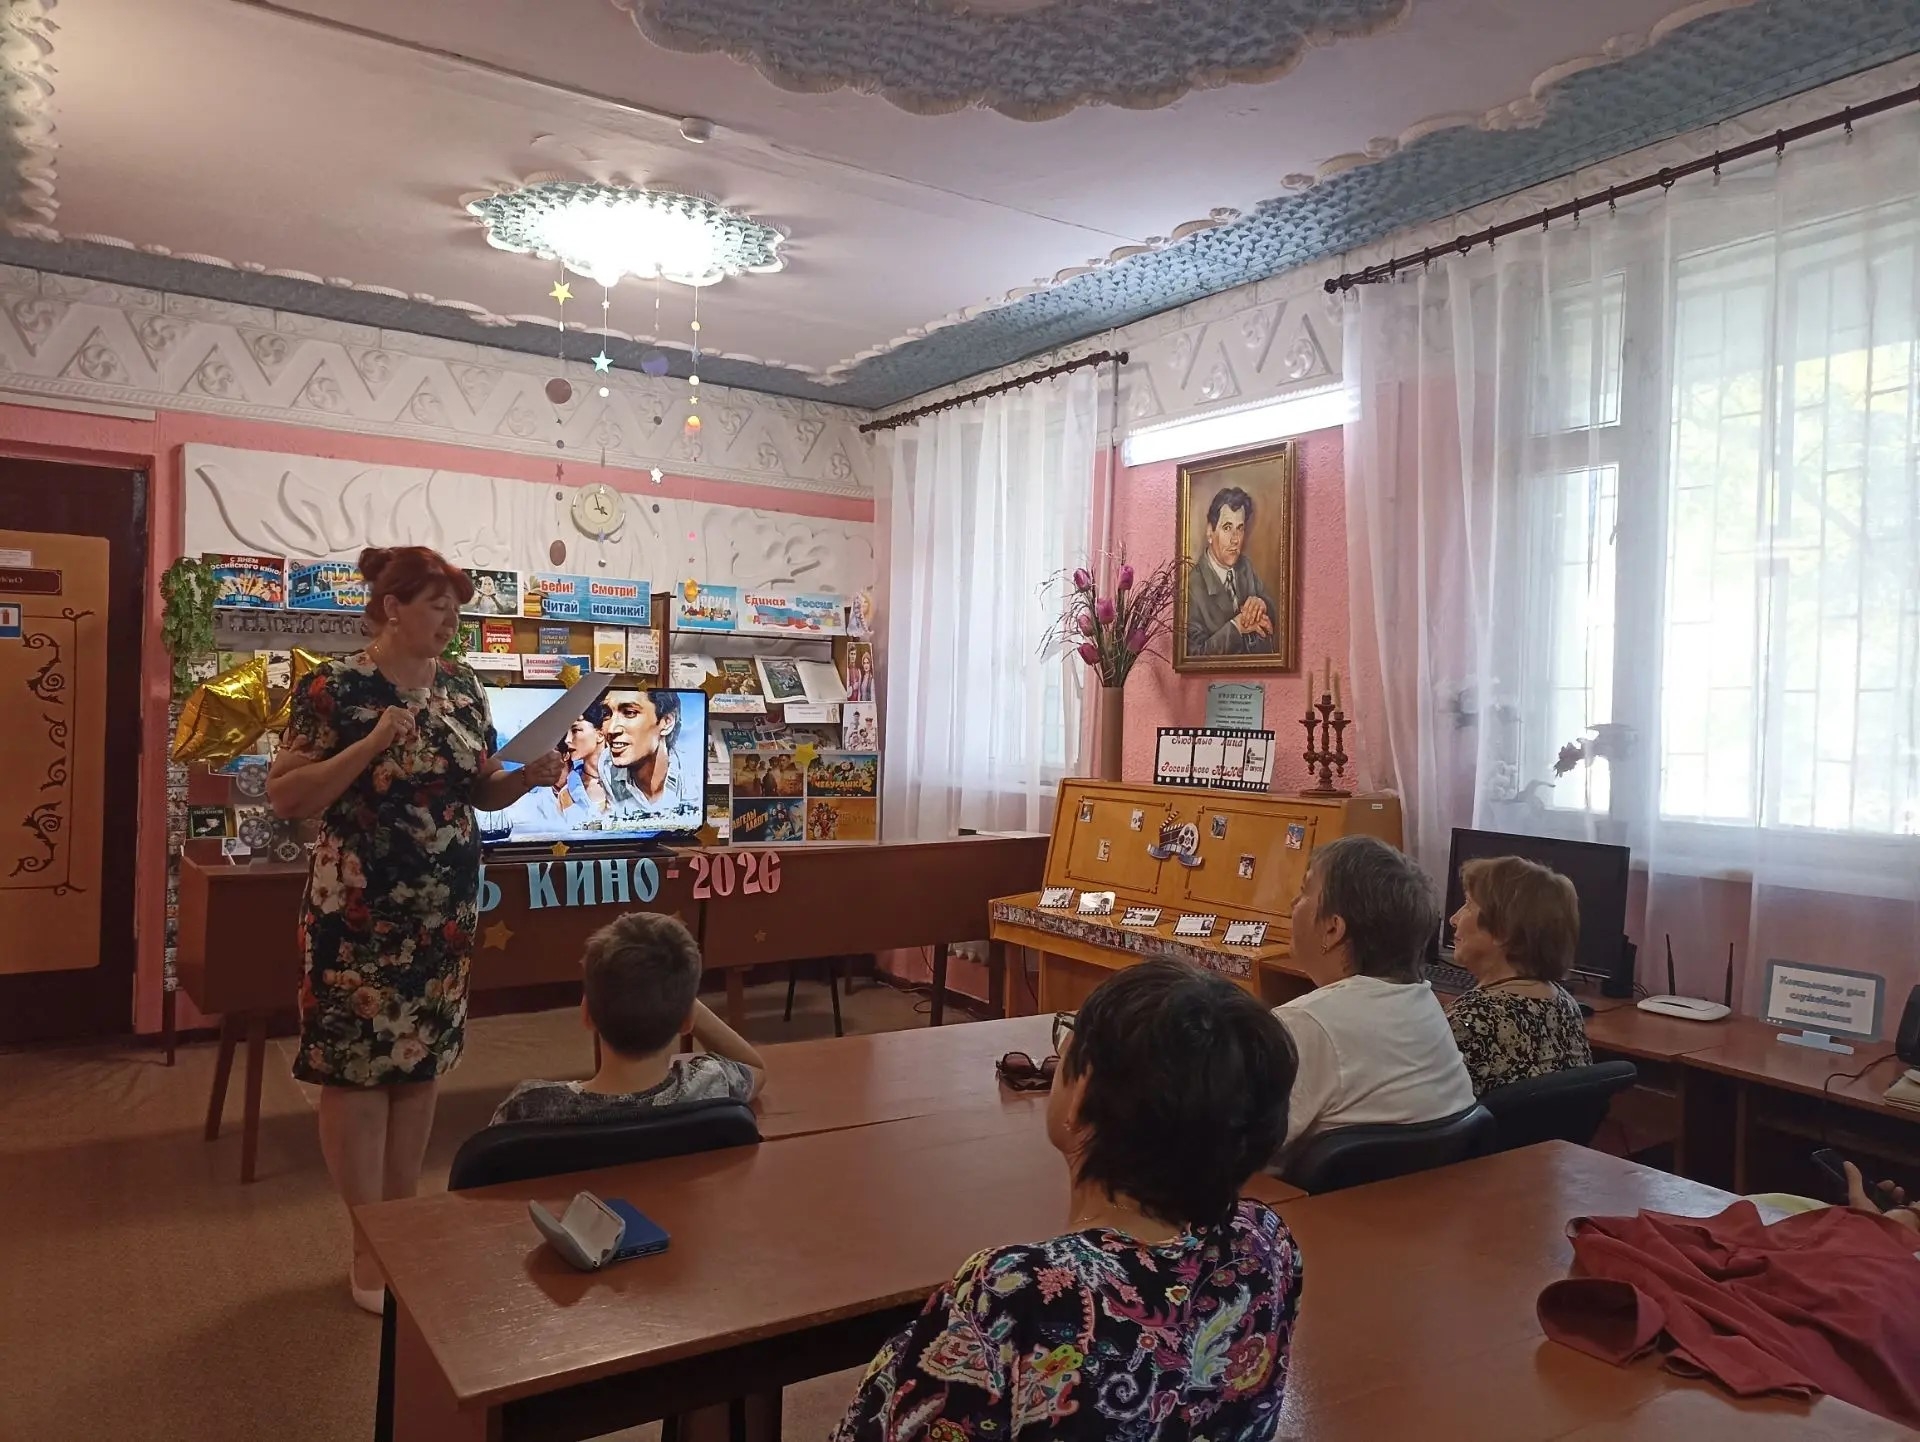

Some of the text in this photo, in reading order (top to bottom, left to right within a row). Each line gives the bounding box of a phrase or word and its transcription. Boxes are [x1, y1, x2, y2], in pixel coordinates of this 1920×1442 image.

[210, 562, 282, 576] ОССИЙСКОГО КИНО!
[322, 566, 365, 582] ПЛА
[540, 579, 638, 598] Бери! Смотри!
[543, 598, 644, 617] Читай новинки!
[744, 594, 786, 607] Единая
[795, 597, 833, 610] Россия
[1171, 736, 1213, 745] Любмые
[1161, 761, 1210, 774] Российкого
[862, 779, 872, 792] 2
[478, 865, 502, 912] Ь
[527, 857, 660, 910] КИНО
[688, 850, 782, 900] 2026
